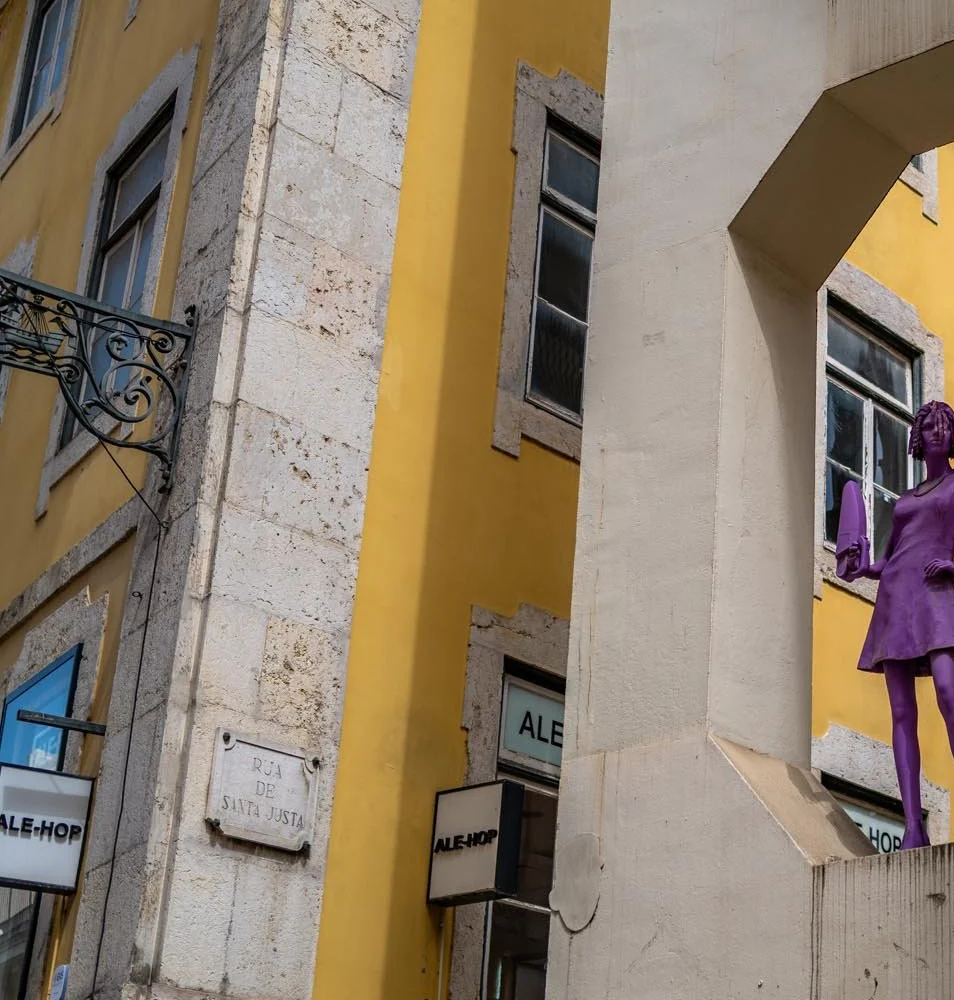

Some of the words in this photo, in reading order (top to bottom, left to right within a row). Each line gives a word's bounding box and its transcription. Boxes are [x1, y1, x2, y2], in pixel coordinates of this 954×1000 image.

[519, 710, 563, 748] ALE
[253, 757, 282, 779] RUA
[256, 780, 276, 799] DE
[222, 795, 260, 818] SANTA
[267, 807, 305, 830] JUSTA
[0, 813, 82, 840] ALE-HOP
[434, 829, 498, 853] ALE-HOP
